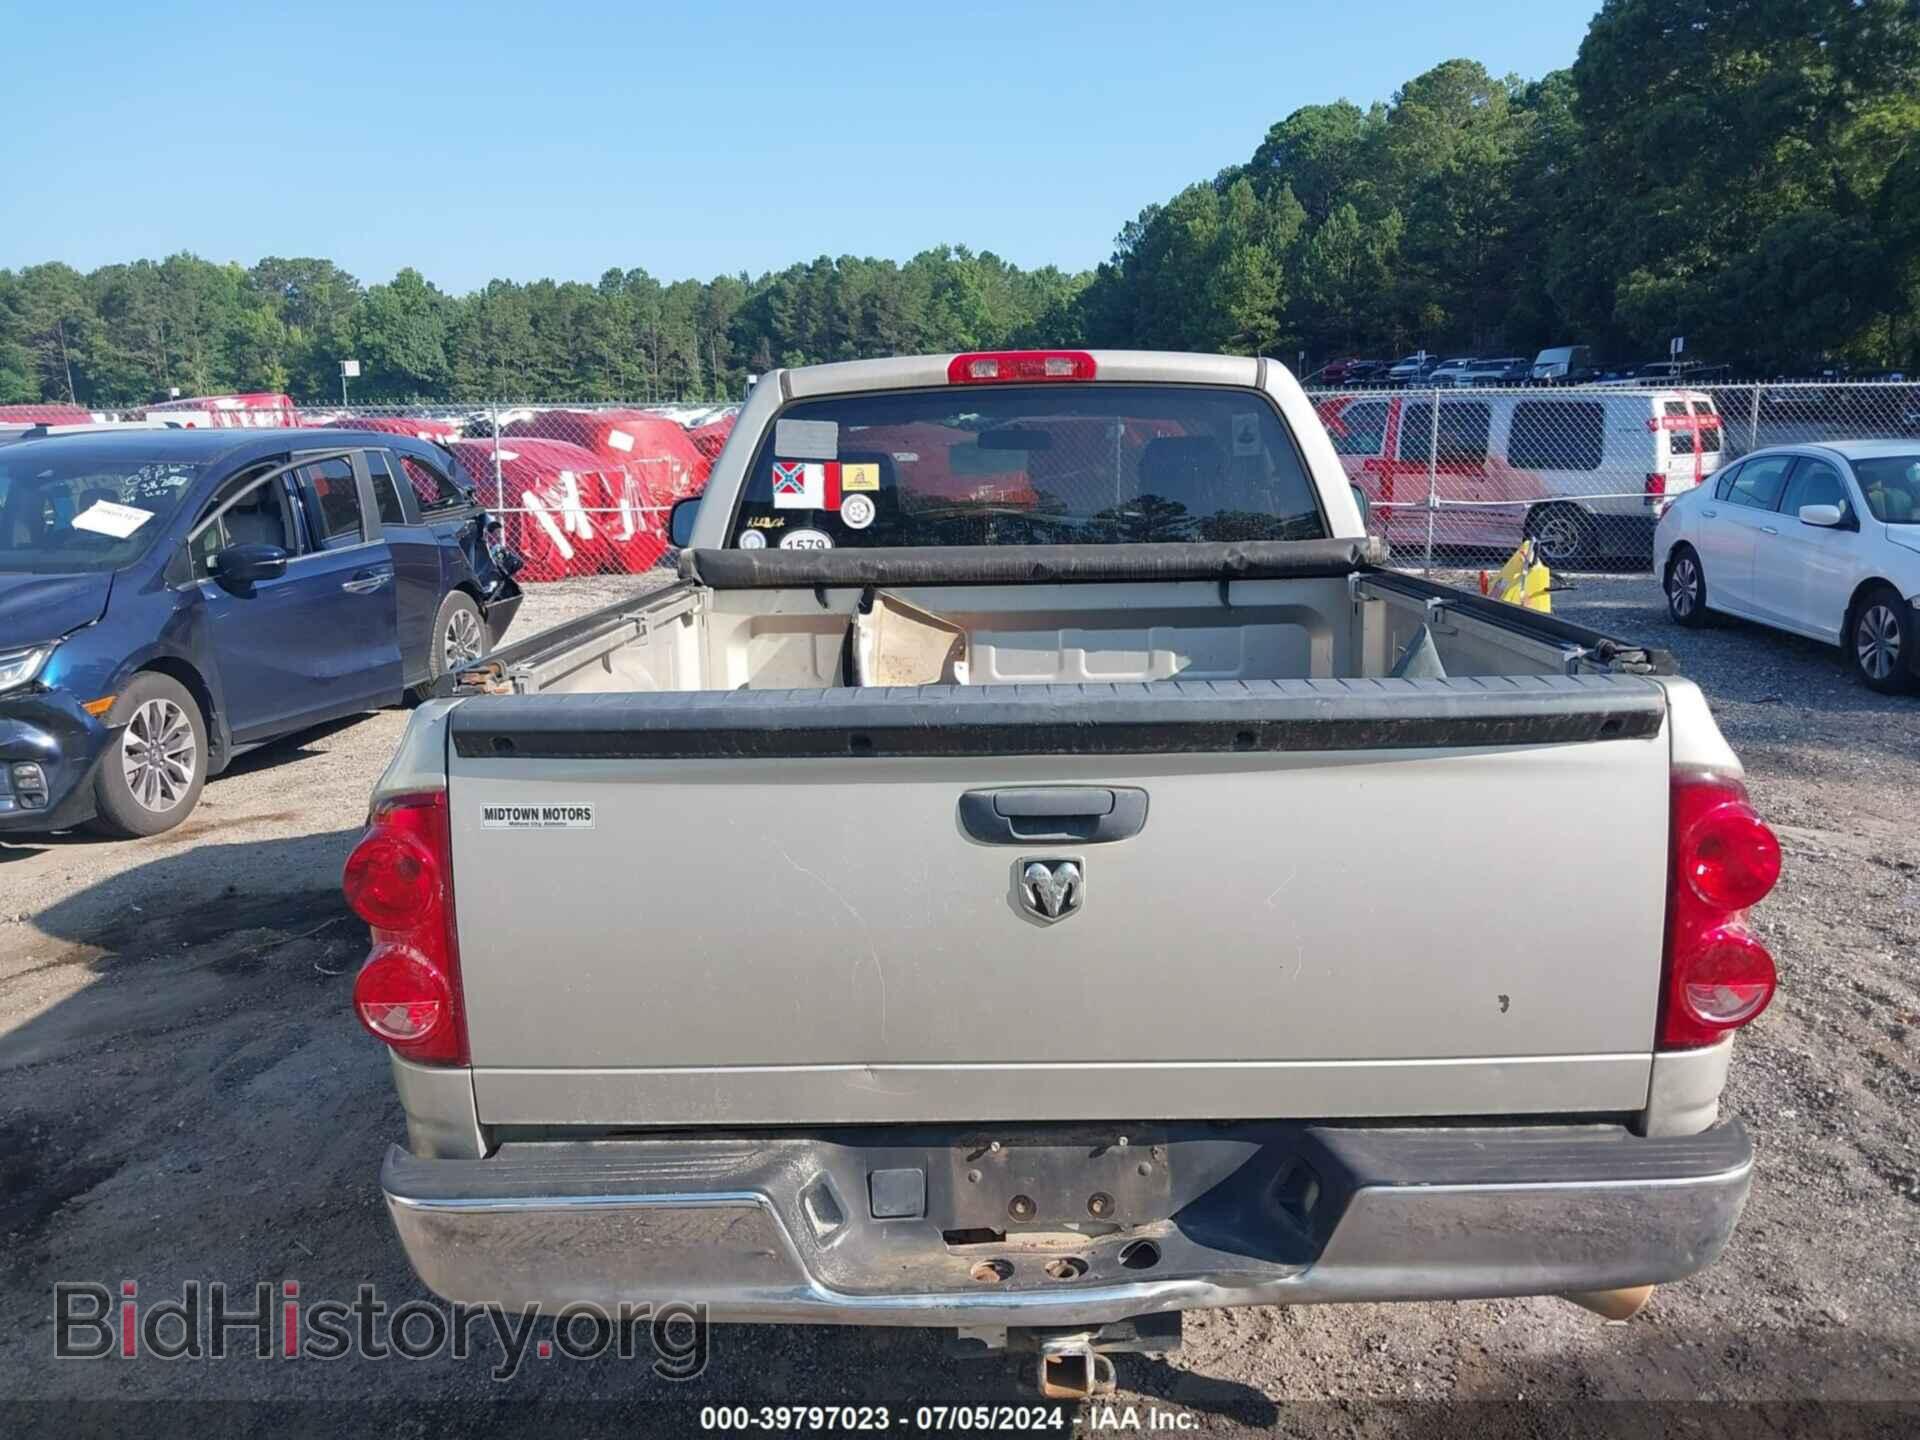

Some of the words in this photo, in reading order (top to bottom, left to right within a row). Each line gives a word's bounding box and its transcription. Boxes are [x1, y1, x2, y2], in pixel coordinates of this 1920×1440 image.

[786, 539, 825, 549] 1579
[484, 807, 539, 820] MIDTOWN
[543, 807, 591, 820] MOTORS
